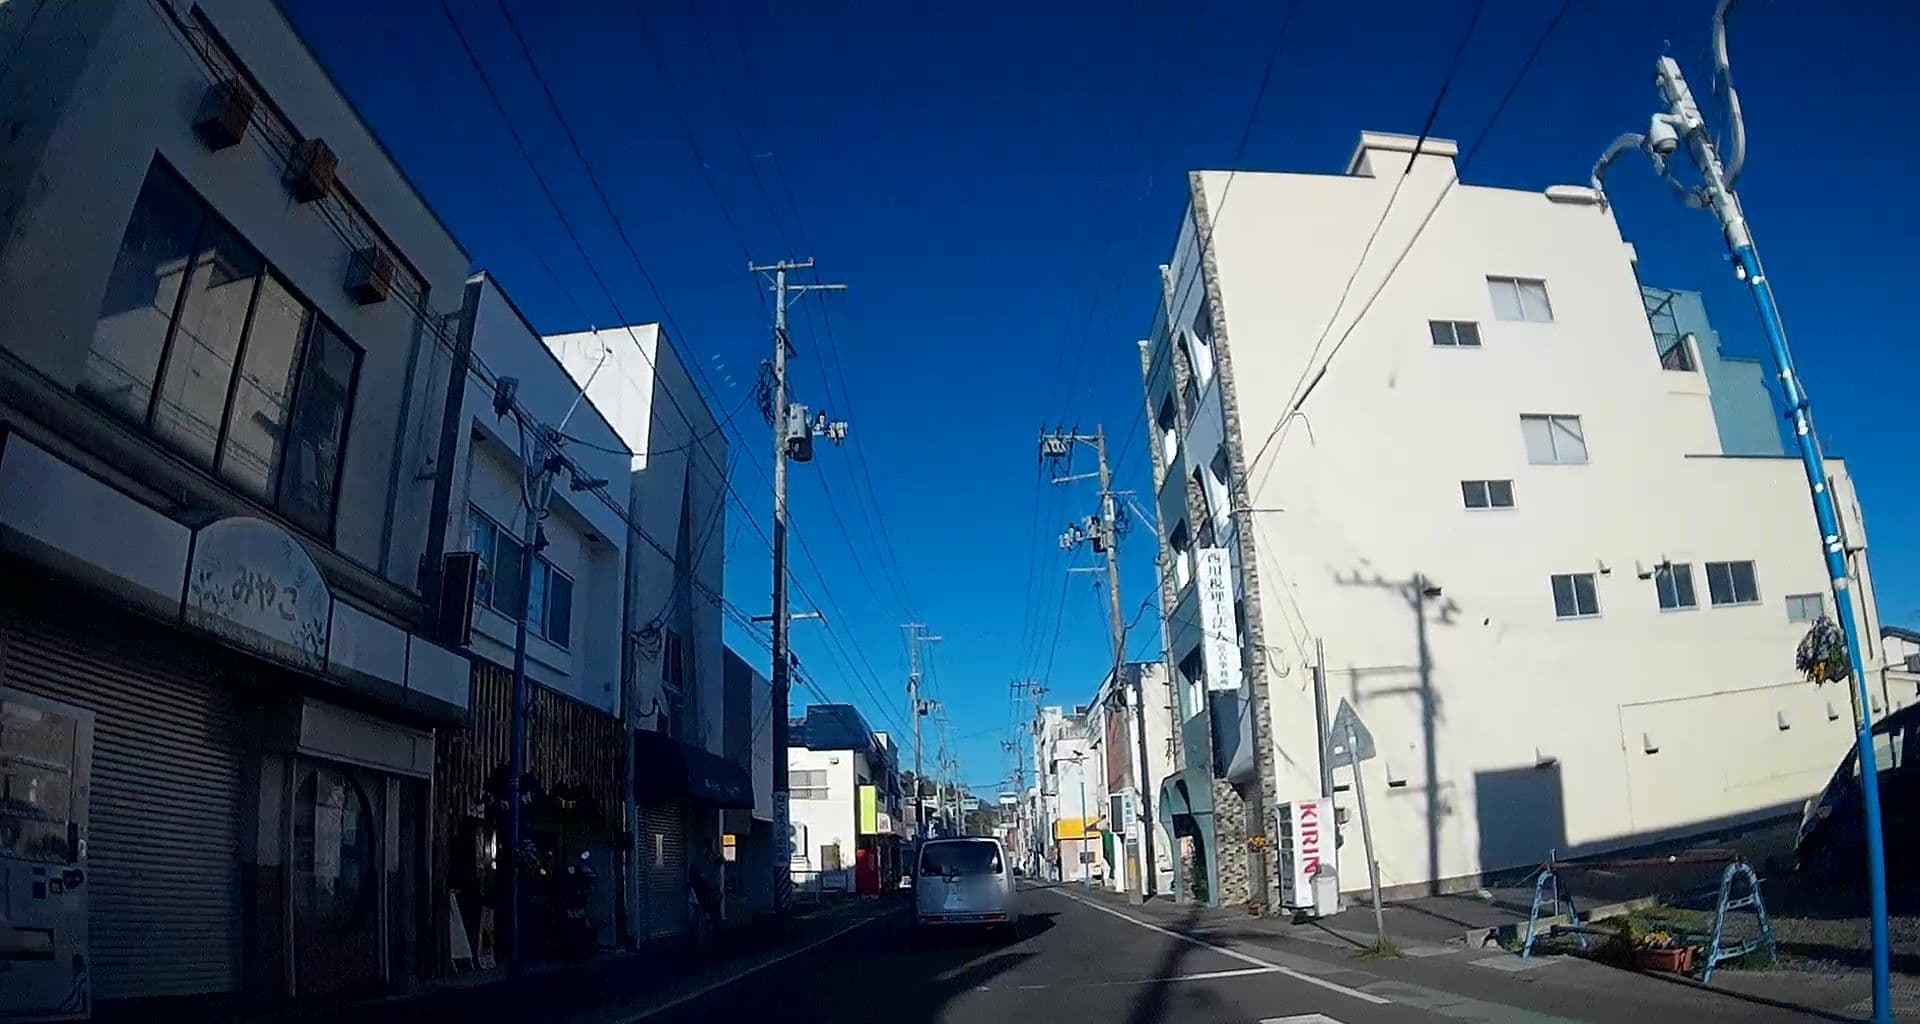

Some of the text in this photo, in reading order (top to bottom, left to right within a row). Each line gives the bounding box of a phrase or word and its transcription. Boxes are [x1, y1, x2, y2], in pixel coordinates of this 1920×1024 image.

[232, 566, 298, 621] みやこ
[1299, 803, 1322, 875] KIRIN
